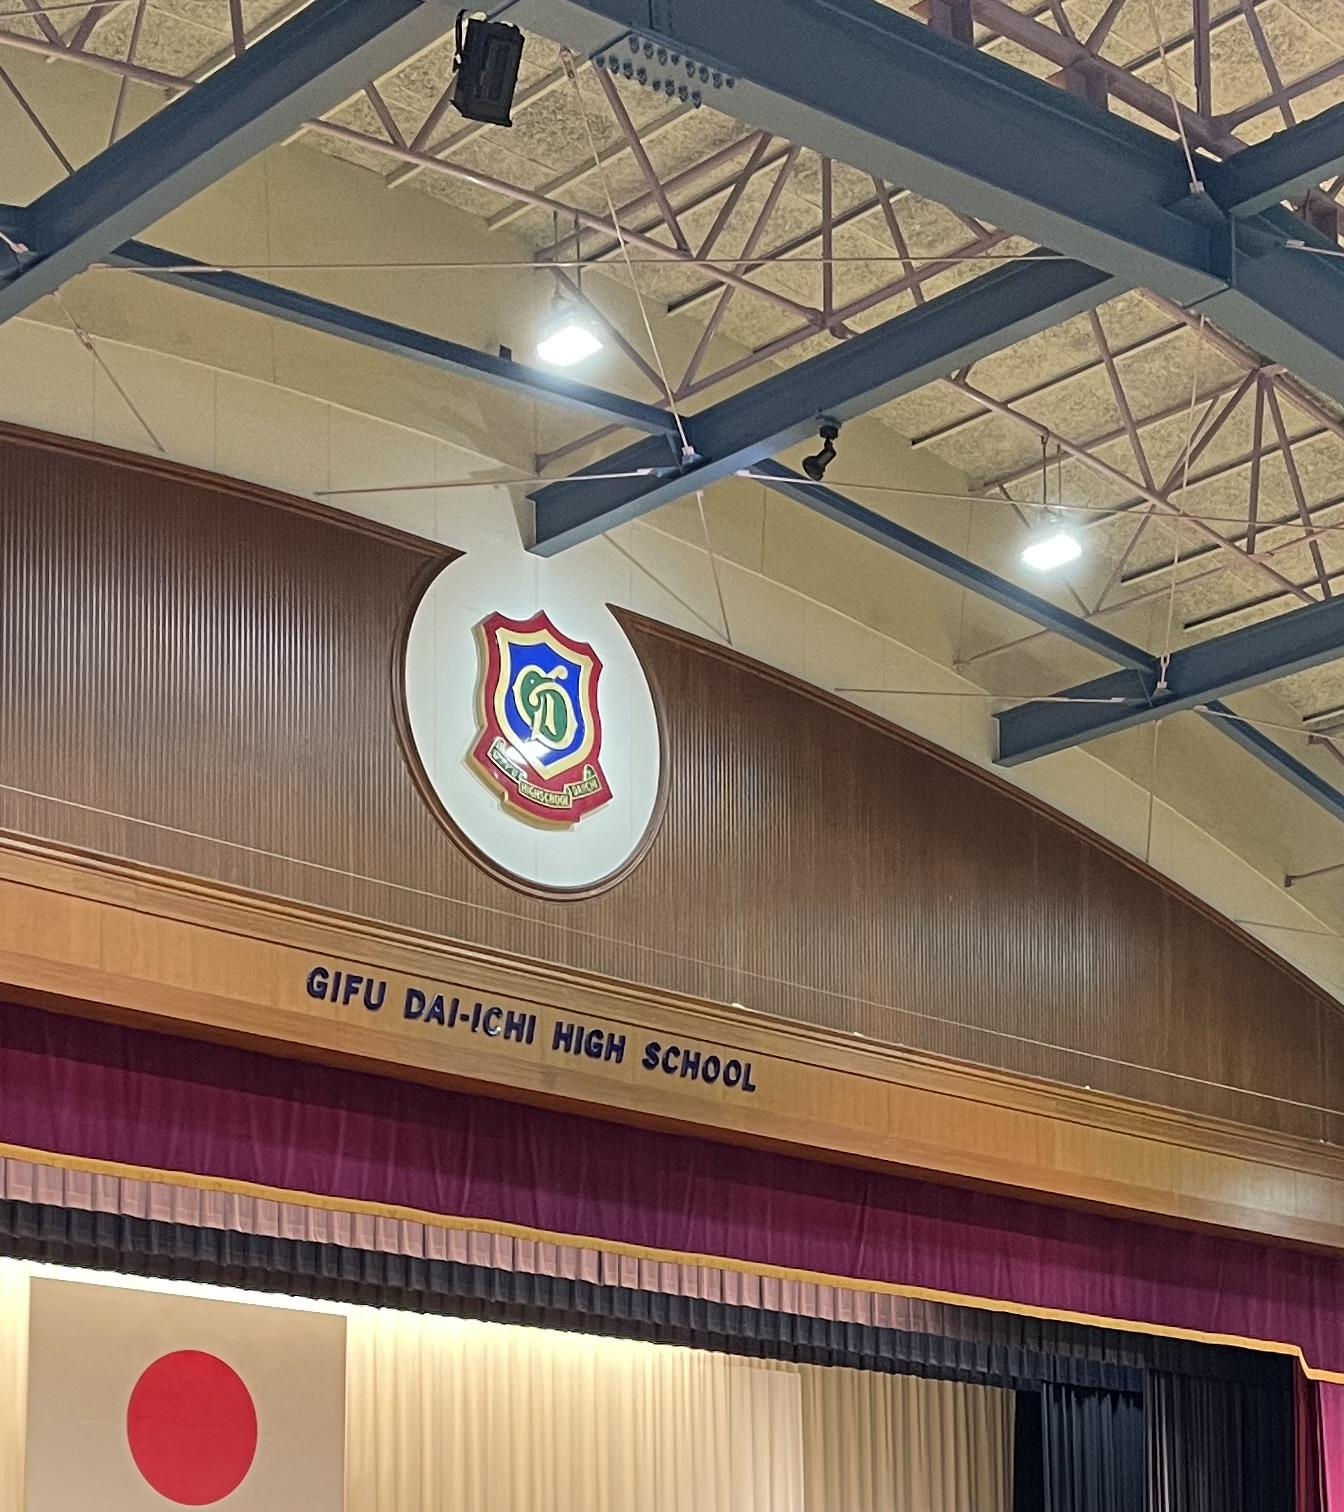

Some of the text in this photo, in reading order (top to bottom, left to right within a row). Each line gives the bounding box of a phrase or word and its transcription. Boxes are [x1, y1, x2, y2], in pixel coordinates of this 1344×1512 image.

[306, 966, 757, 1093] GIFU DAI-ICHI HIGH SCHOOL
